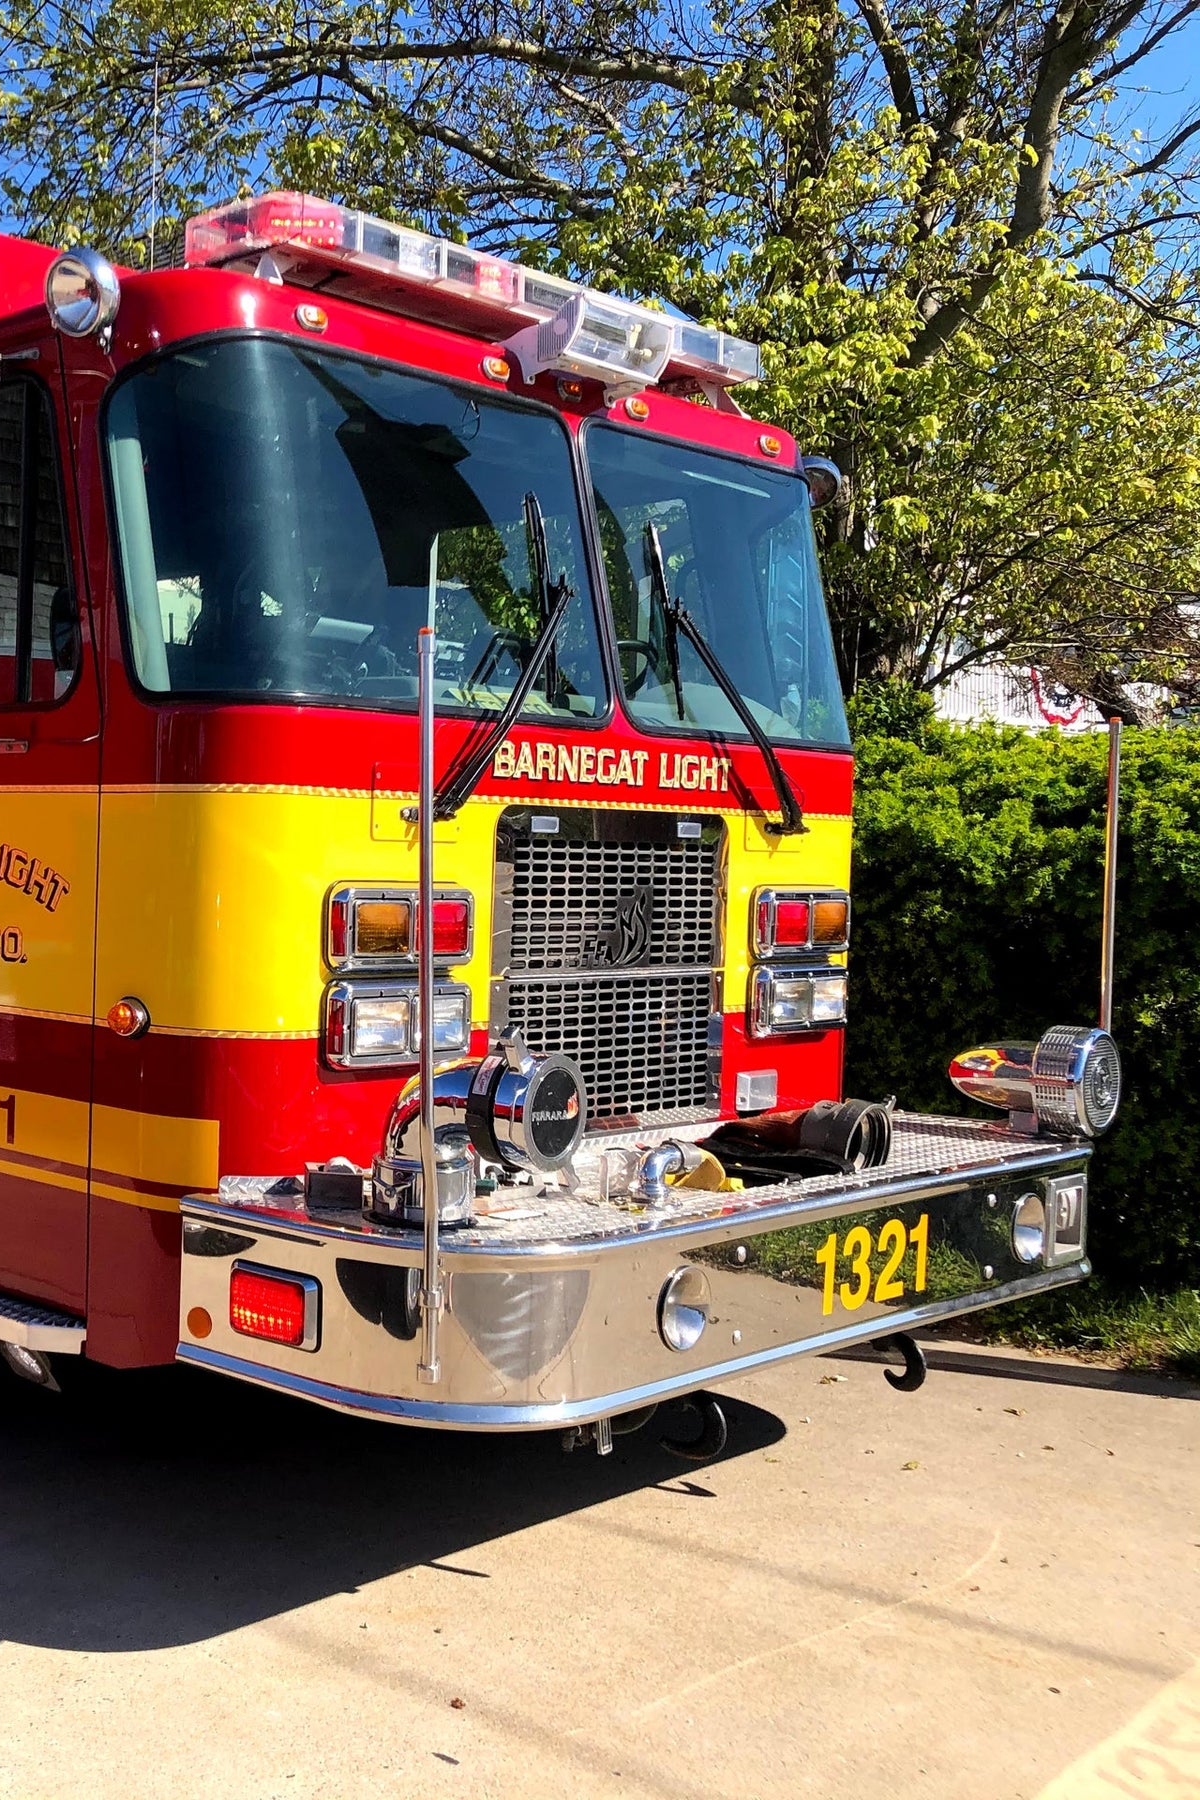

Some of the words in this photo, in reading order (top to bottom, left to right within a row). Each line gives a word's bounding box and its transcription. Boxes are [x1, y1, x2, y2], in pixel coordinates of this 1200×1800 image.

[493, 740, 648, 787] BARNEGAT
[659, 753, 732, 792] LIGHT
[816, 1213, 929, 1316] 1321
